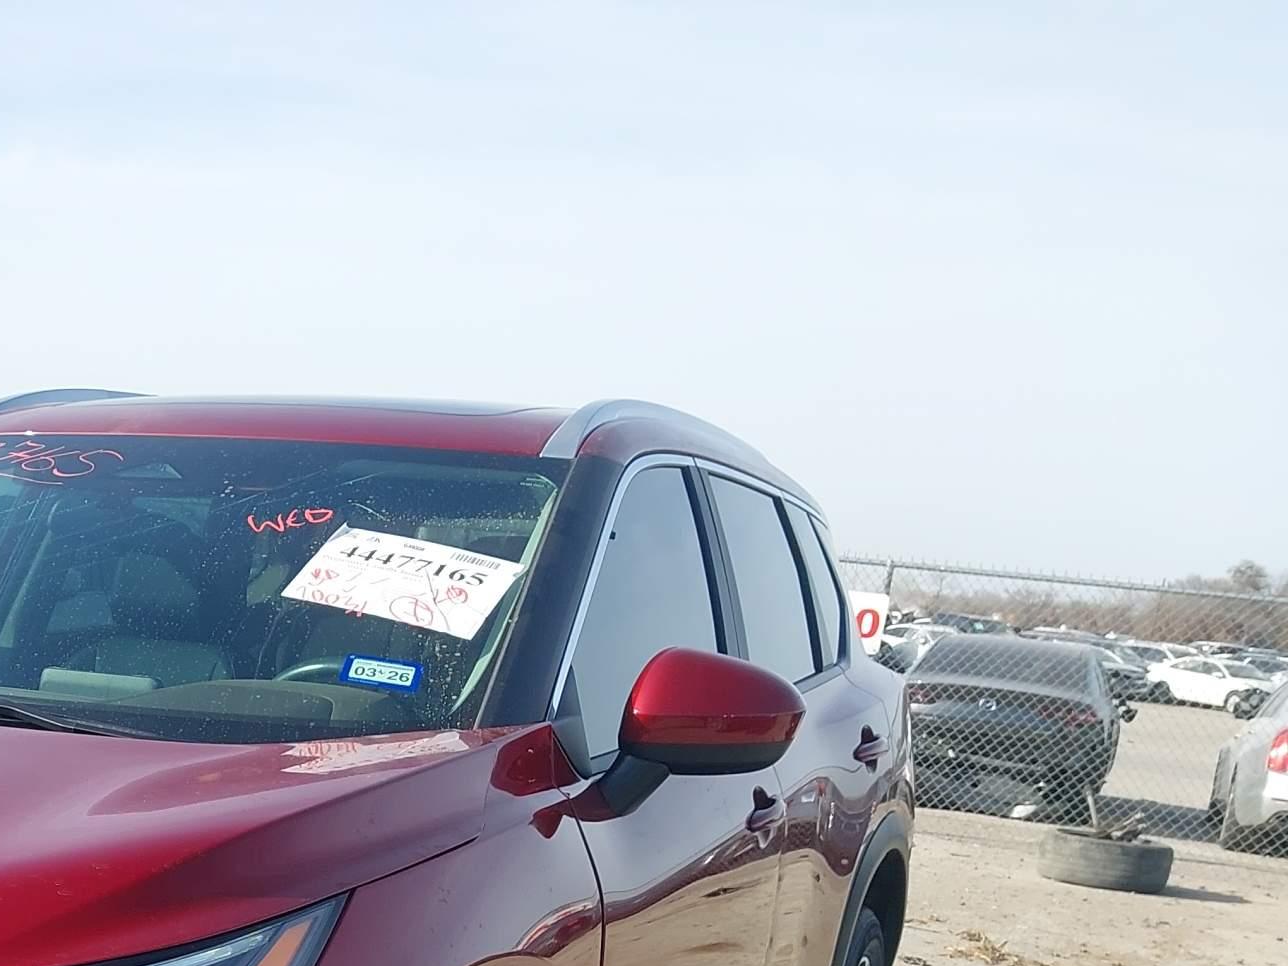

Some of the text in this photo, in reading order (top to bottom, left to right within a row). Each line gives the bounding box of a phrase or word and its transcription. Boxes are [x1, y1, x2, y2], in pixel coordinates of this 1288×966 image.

[247, 508, 333, 533] WED
[339, 546, 488, 586] 44477165
[354, 666, 377, 677] 03
[386, 670, 410, 682] 26
